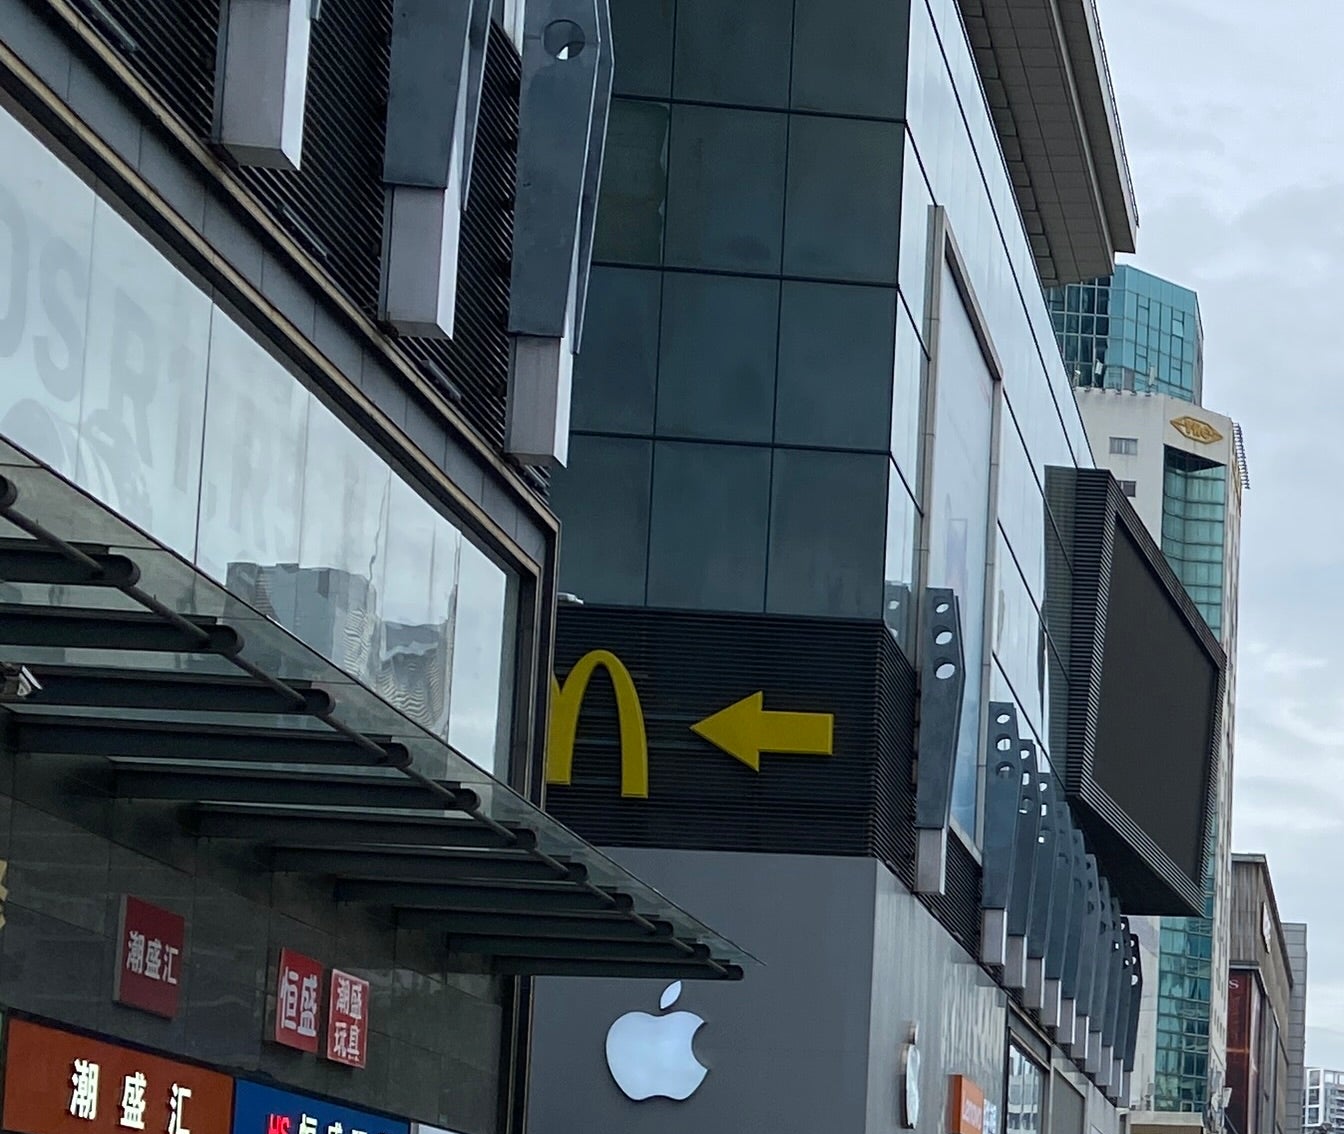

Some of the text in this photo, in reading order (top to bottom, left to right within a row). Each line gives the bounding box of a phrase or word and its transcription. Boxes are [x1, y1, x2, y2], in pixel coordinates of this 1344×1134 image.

[126, 930, 178, 985] 潮盛汇
[279, 966, 318, 1037] 恒盛
[336, 977, 363, 1020] 潮盛
[333, 1022, 361, 1062] 玩具
